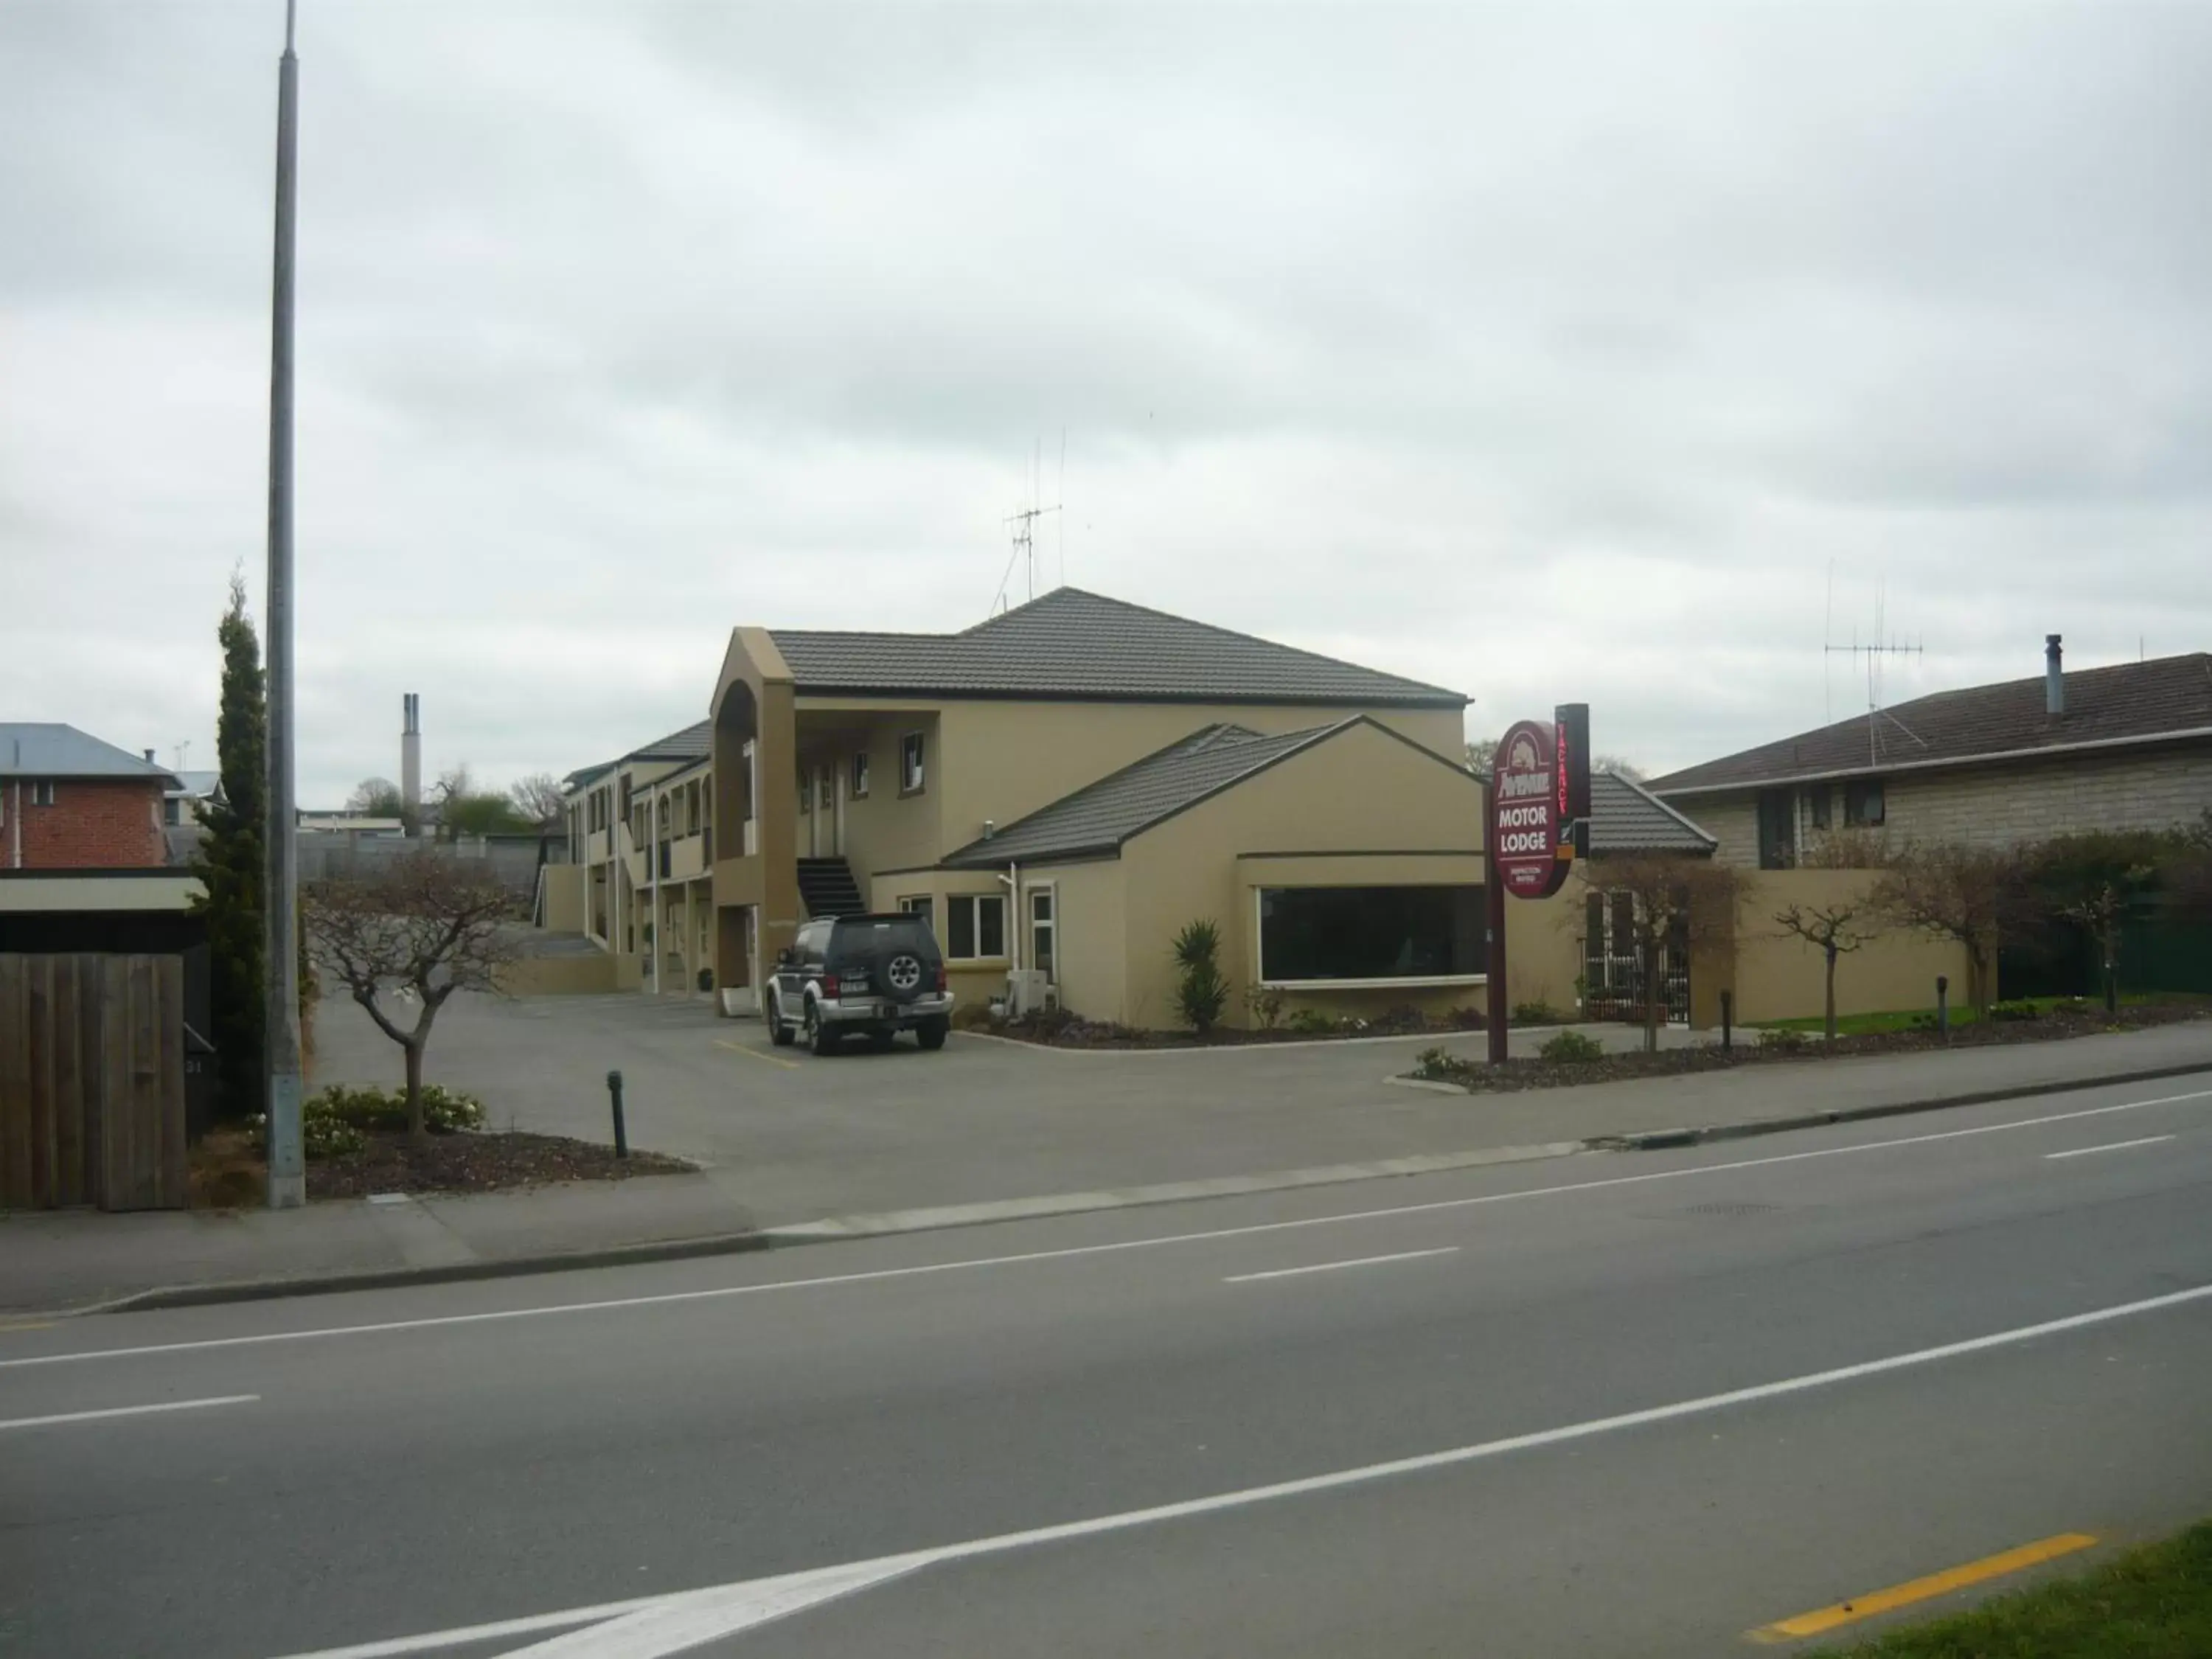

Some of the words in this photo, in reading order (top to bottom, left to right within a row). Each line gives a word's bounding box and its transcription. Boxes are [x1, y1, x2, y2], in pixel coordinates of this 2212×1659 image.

[1498, 772, 1549, 798] AVENUE
[1499, 806, 1547, 828] MOTOR
[1500, 832, 1546, 852] LODGE
